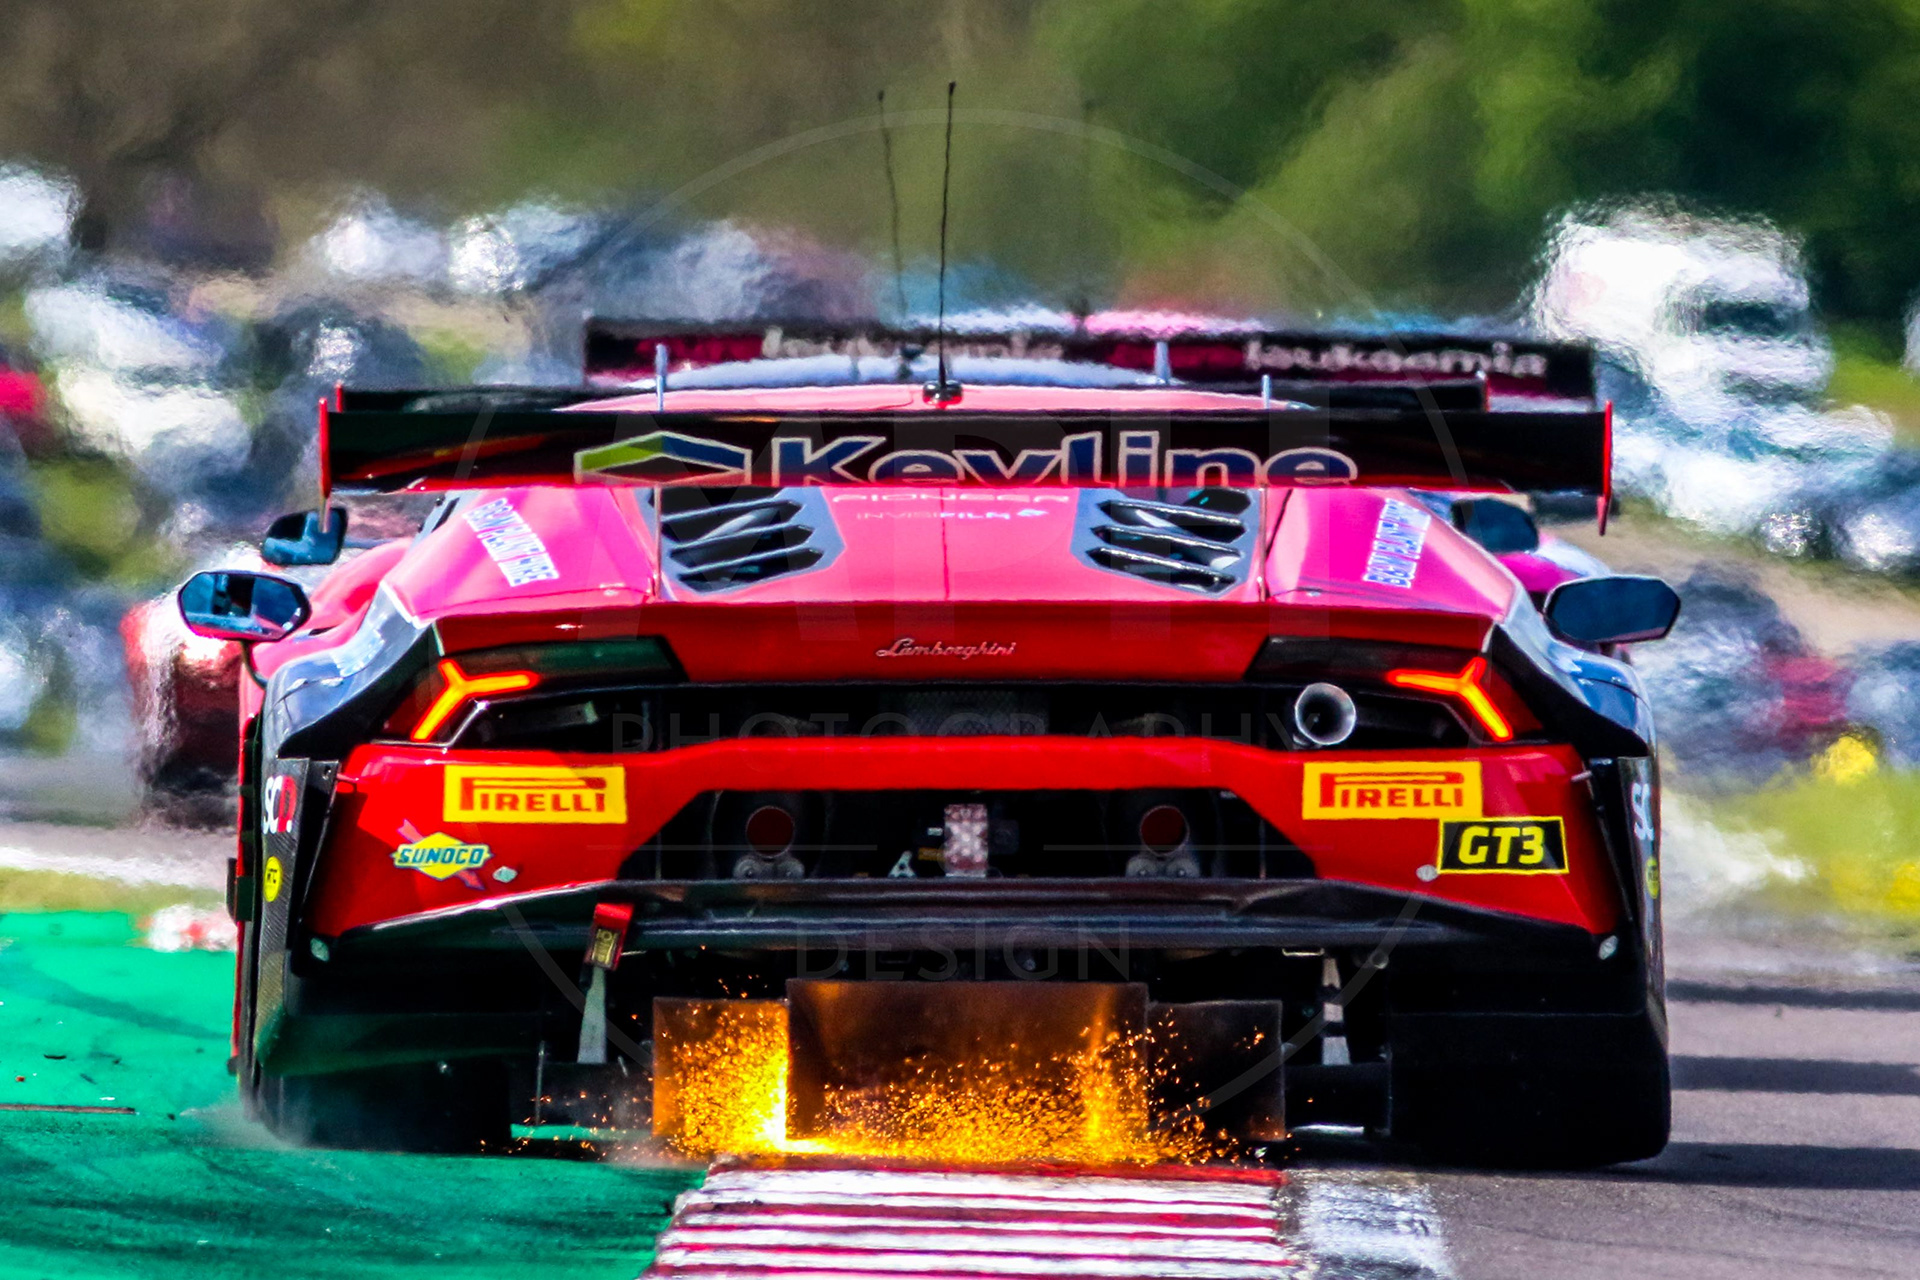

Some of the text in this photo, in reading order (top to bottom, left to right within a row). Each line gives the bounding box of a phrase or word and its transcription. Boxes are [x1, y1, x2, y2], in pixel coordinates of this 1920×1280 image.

[875, 637, 1017, 660] Lamborghini
[459, 776, 608, 812] PIRELLI
[1319, 771, 1465, 808] PIRELLI
[398, 847, 485, 866] SUNOCO
[1458, 826, 1545, 865] GT3
